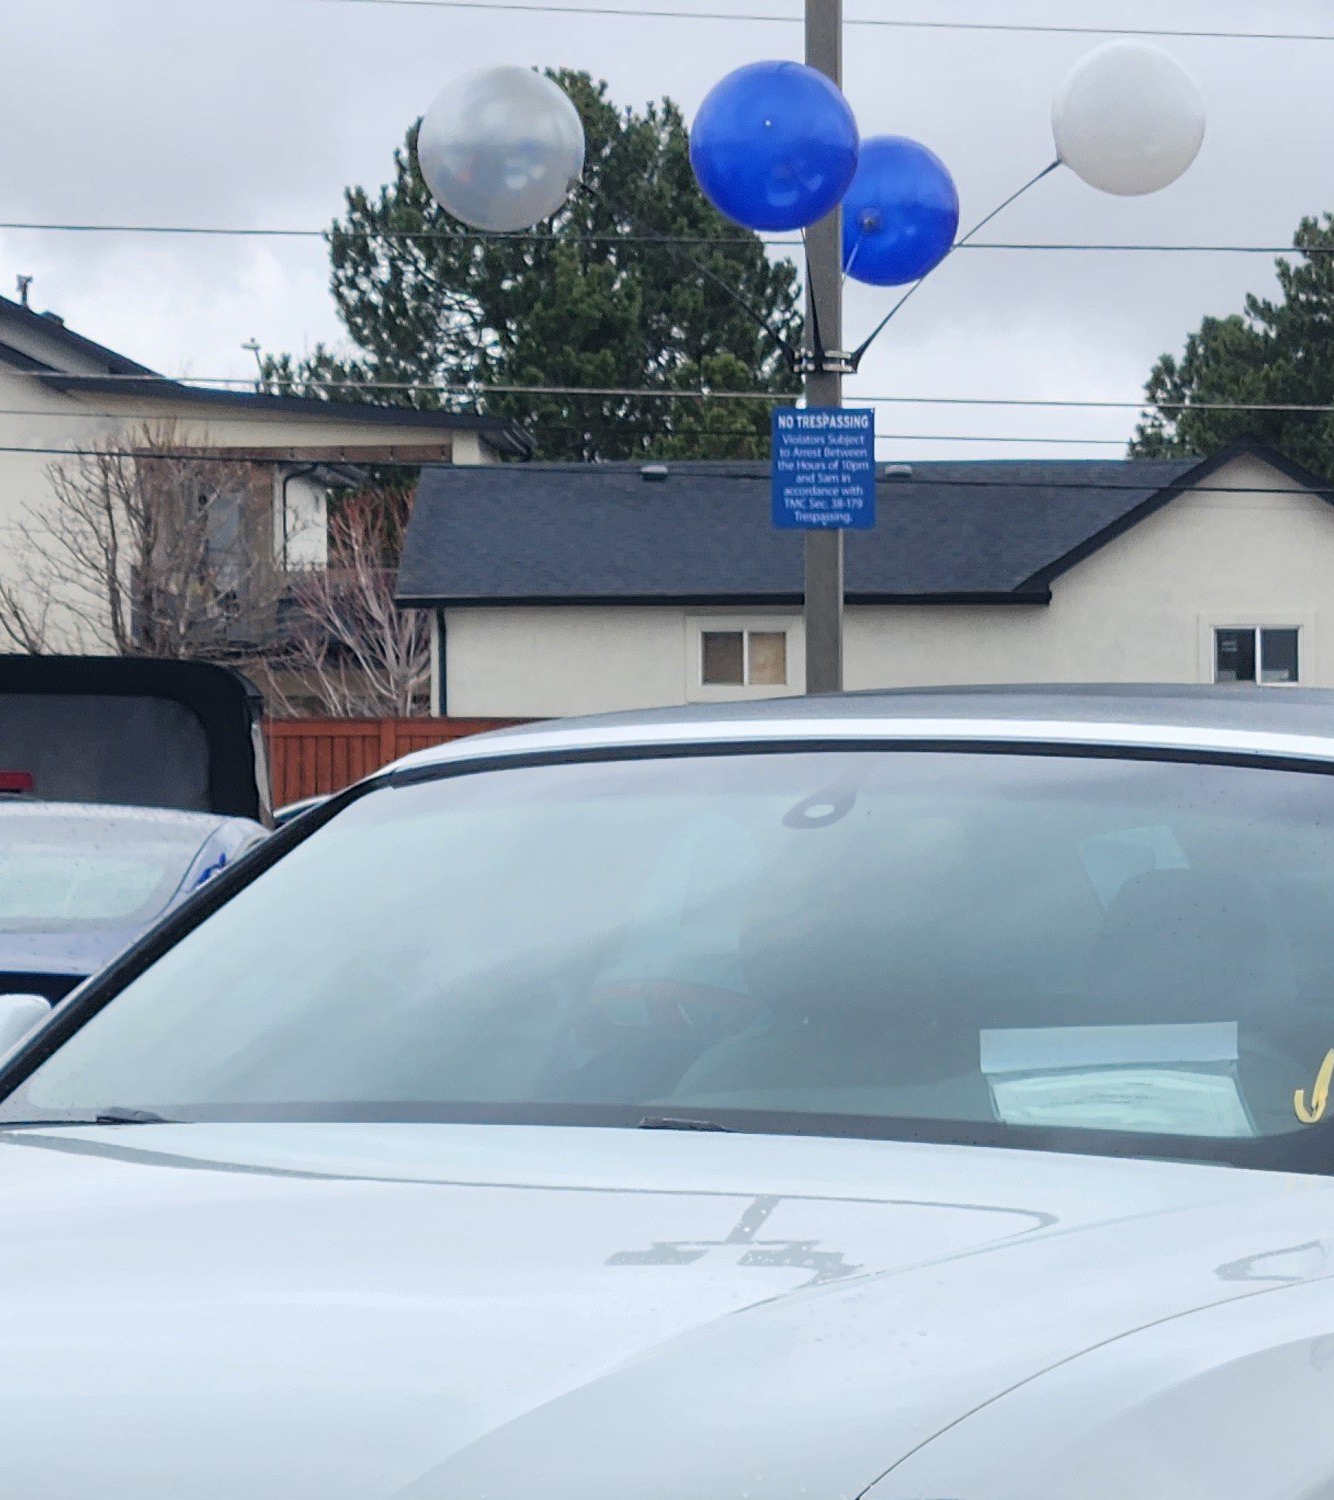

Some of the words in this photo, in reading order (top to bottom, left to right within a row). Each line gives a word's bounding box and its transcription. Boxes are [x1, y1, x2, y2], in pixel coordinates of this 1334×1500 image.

[778, 415, 793, 429] NO
[796, 415, 869, 429] TRESPASSING
[782, 434, 825, 445] Violators
[828, 434, 865, 446] Subject
[779, 447, 790, 458] to
[793, 447, 821, 458] Arrest
[824, 447, 868, 458] Between
[777, 460, 794, 471] the
[797, 460, 825, 471] Hours
[828, 460, 839, 471] of
[842, 460, 869, 473] 10pm
[795, 473, 815, 484] and
[841, 473, 851, 484] in
[783, 486, 839, 496] accordance
[841, 486, 864, 496] with
